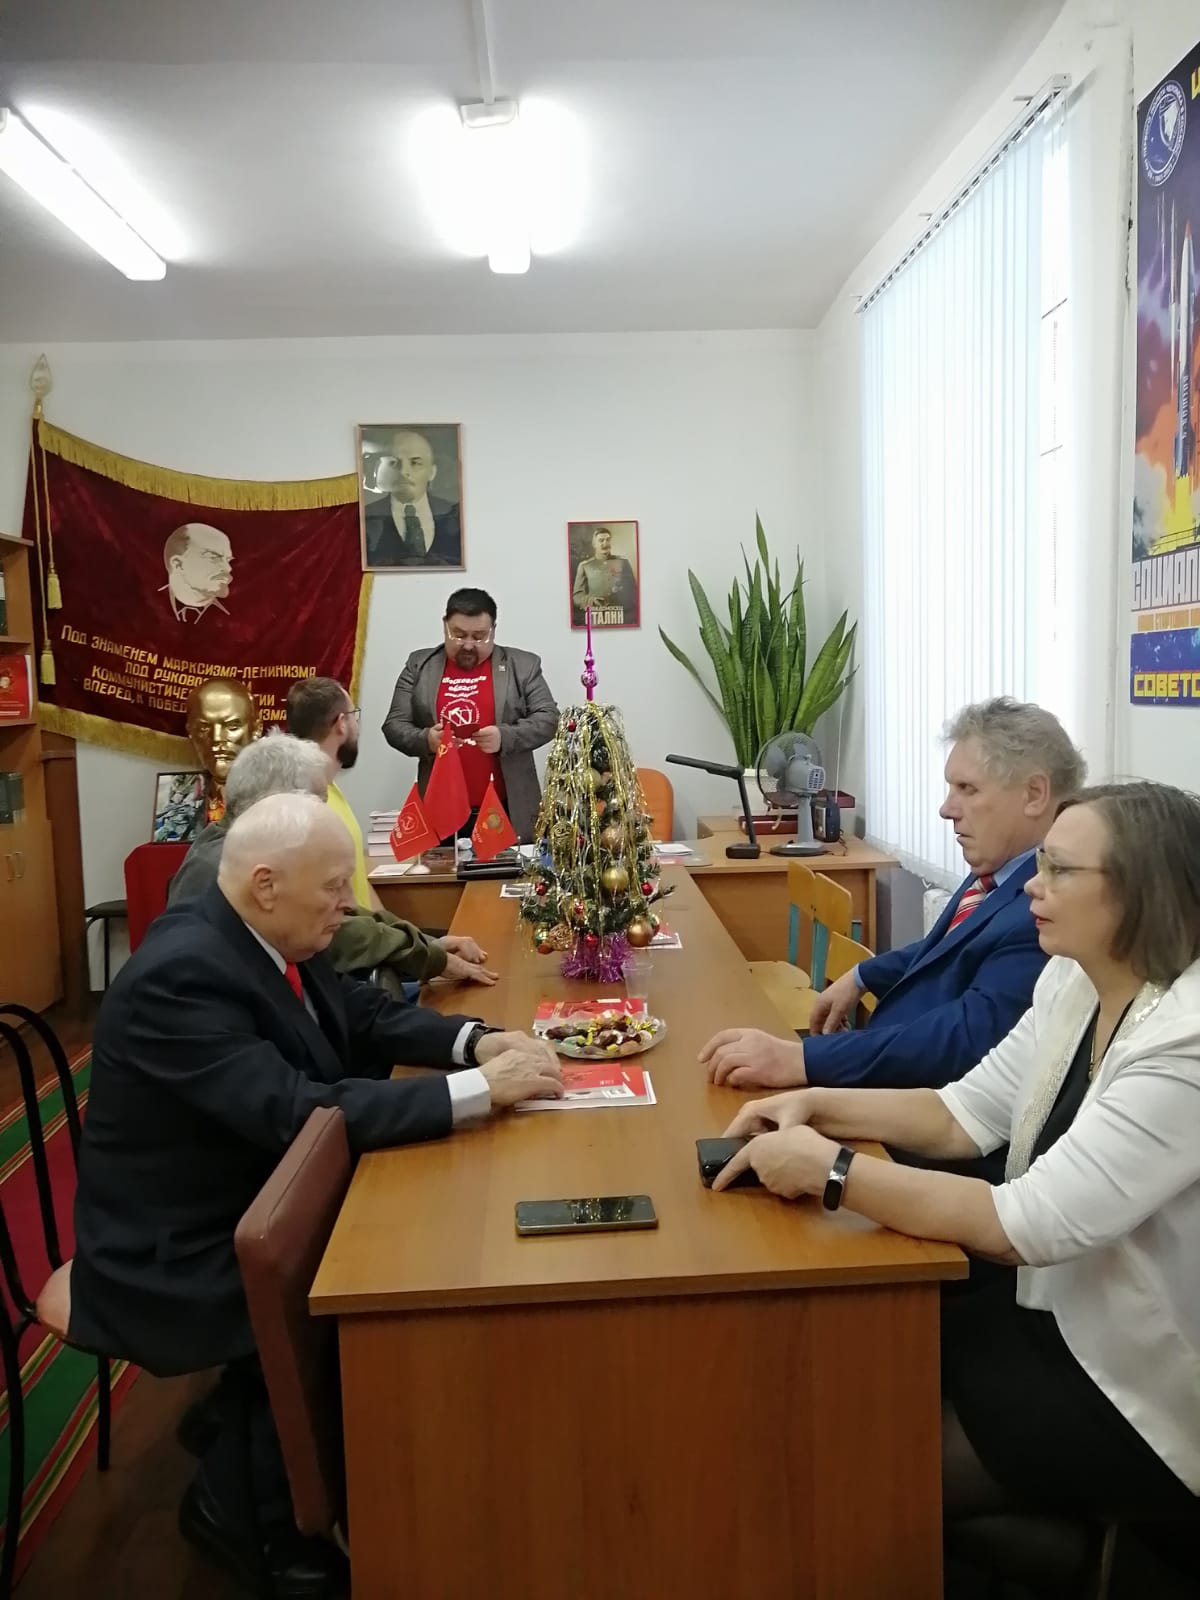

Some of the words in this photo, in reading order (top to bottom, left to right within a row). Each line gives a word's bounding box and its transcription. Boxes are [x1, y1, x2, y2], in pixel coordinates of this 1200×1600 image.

[1132, 547, 1200, 609] СОЦИАЛ
[91, 636, 158, 665] ЗНАМЕНЕМ
[163, 655, 316, 679] МАРКСИЗМА-ЛЕНИНИЗМА
[125, 661, 149, 678] ПОД
[91, 665, 193, 700] КОММУНИСТИЧЕ
[148, 696, 188, 714] ПОБЕД
